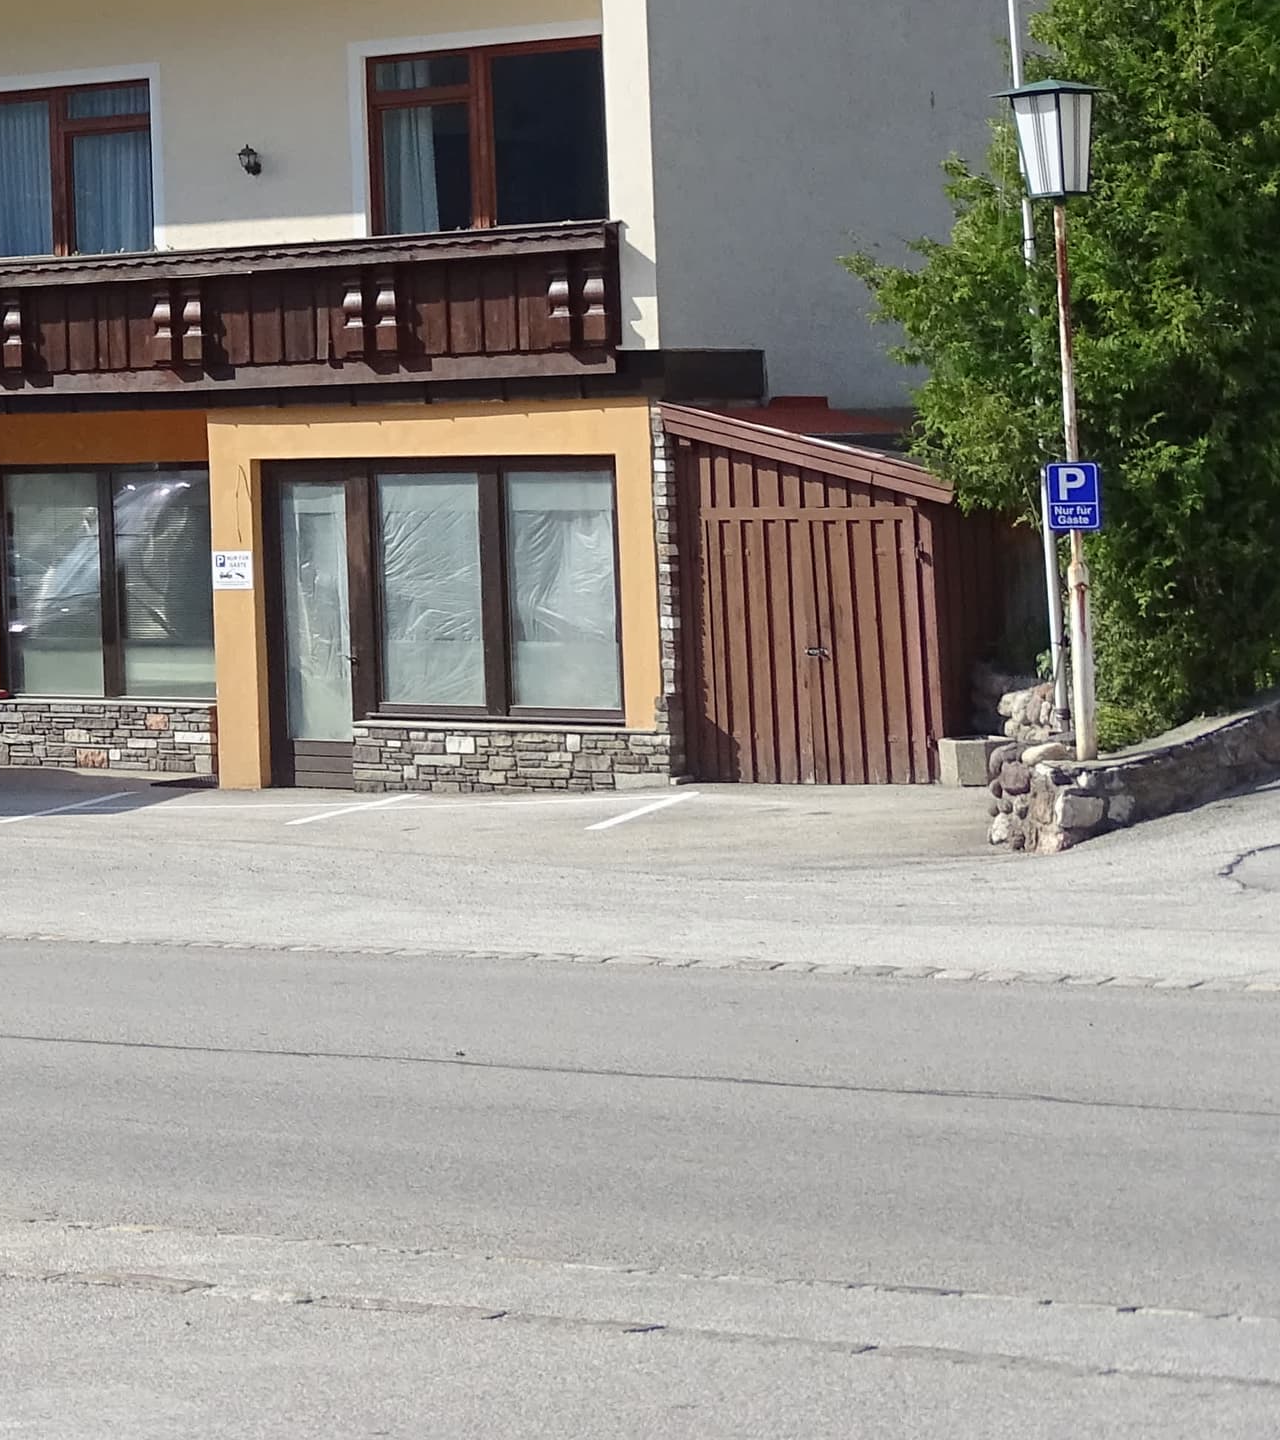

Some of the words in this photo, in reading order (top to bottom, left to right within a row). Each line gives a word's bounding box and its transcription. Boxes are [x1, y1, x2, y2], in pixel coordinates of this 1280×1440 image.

[1058, 467, 1086, 500] P
[1054, 506, 1074, 515] Nur
[1076, 505, 1092, 515] für
[1057, 515, 1089, 524] Gäste
